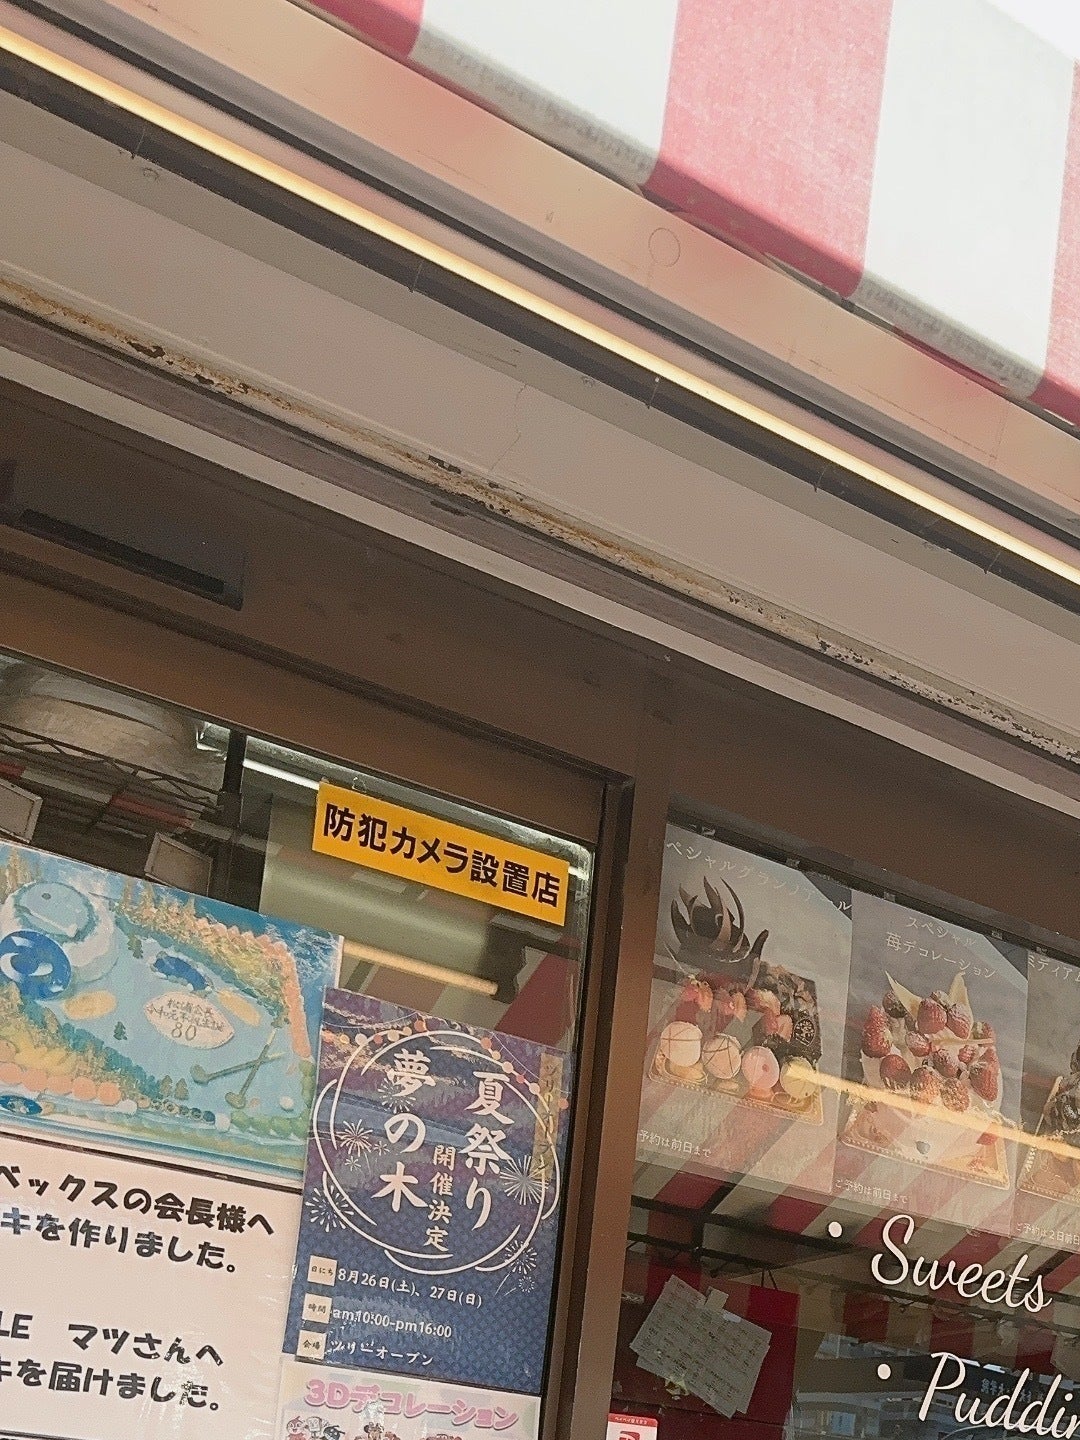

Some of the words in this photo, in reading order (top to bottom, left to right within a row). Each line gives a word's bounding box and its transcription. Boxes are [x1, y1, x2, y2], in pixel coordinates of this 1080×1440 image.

[323, 803, 560, 907] 防犯カメラ設置店
[886, 931, 996, 978] 苺デコレーション
[906, 916, 977, 945] スペシャル
[171, 1022, 196, 1041] 80
[371, 1049, 435, 1212] 夢の木
[459, 1071, 514, 1230] 夏祭り
[0, 1165, 274, 1235] ベックスの会長様へ
[423, 1145, 457, 1252] 開催決定
[834, 1178, 908, 1204] ご予約は前日まで
[1, 1207, 236, 1273] キを作りました。
[871, 1214, 1053, 1313] Sweets
[68, 1323, 224, 1366] マツさんへ
[305, 1379, 519, 1430] 3Dデコレーション
